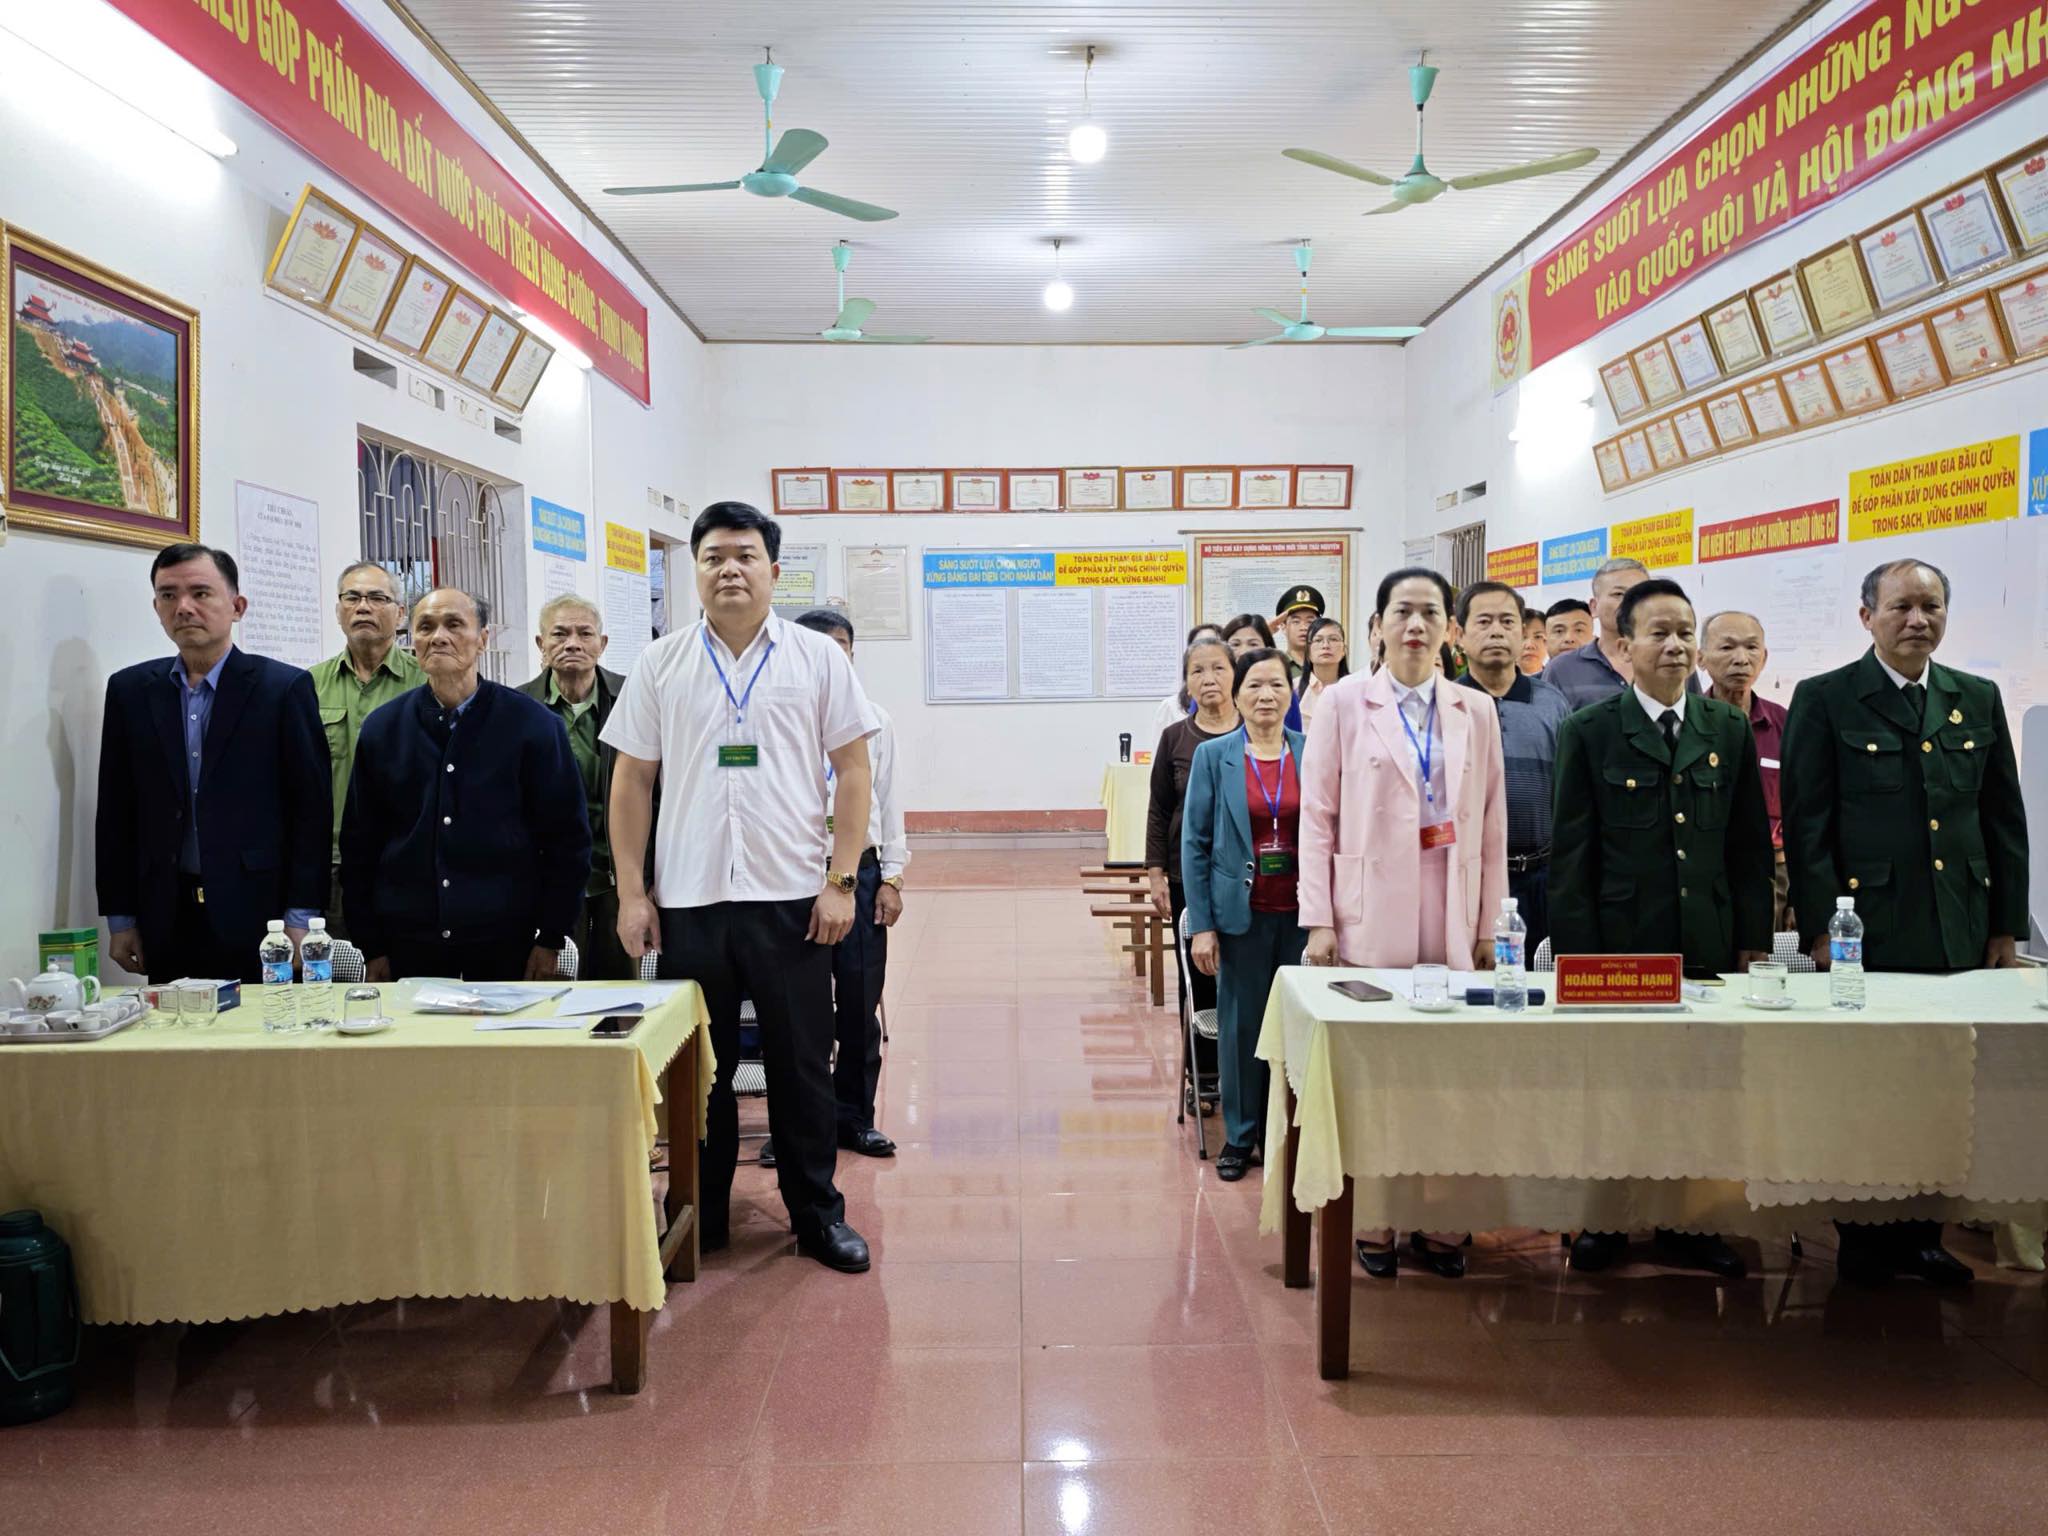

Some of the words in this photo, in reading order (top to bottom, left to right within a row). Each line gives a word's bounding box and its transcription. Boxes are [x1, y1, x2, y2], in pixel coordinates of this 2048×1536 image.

[1546, 238, 1589, 297] SÁNG
[1593, 192, 1642, 263] SUỐT
[1647, 164, 1688, 225] LỰA
[1696, 113, 1767, 191] CHỌN
[1775, 15, 1892, 137] NHỮNG
[305, 33, 363, 141] PHẦN
[365, 82, 402, 174] ĐƯA
[403, 113, 433, 199] ĐẤT
[435, 148, 474, 233] NƯỚC
[475, 185, 506, 260] PHÁT
[508, 213, 539, 288] TRIỂN
[540, 241, 567, 311] HÙNG
[599, 297, 621, 357] THỊNH
[1595, 269, 1631, 321] VÀO
[1637, 221, 1695, 296] QUỐC
[1702, 193, 1744, 256] HỘI
[1752, 160, 1788, 225] VÀ
[1798, 123, 1854, 200] HỘI
[1864, 50, 1976, 161] ĐỒNG
[1870, 469, 1892, 489] TOÀN
[1893, 465, 1911, 485] DÂN
[1913, 459, 1938, 481] THAM
[1940, 457, 1956, 475] GIA
[1958, 448, 1977, 471] BẦU
[1980, 442, 1994, 466] CỬ
[1852, 496, 1862, 515] ĐỂ
[1863, 496, 1879, 513] GÓP
[1880, 488, 1902, 510] PHẦN
[1904, 485, 1920, 507] XÂY
[1923, 483, 1948, 505] DỰNG
[1950, 476, 1980, 497] CHÍNH
[1983, 466, 2016, 495] QUYỀN
[1752, 521, 1767, 551] SÁCH
[1790, 510, 1810, 544] NGƯỜI
[1811, 509, 1825, 542] ỨNG
[1826, 501, 1837, 539] CỬ
[1872, 516, 1899, 534] TRONG
[1901, 514, 1924, 533] SẠCH,
[1927, 505, 1952, 525] VỮNG
[1954, 500, 1987, 525] MẠNH!
[1077, 576, 1100, 584] TRONG
[1565, 972, 1604, 986] HOÀNG
[1607, 970, 1638, 986] HỒNG
[1641, 974, 1673, 989] HẠNH
